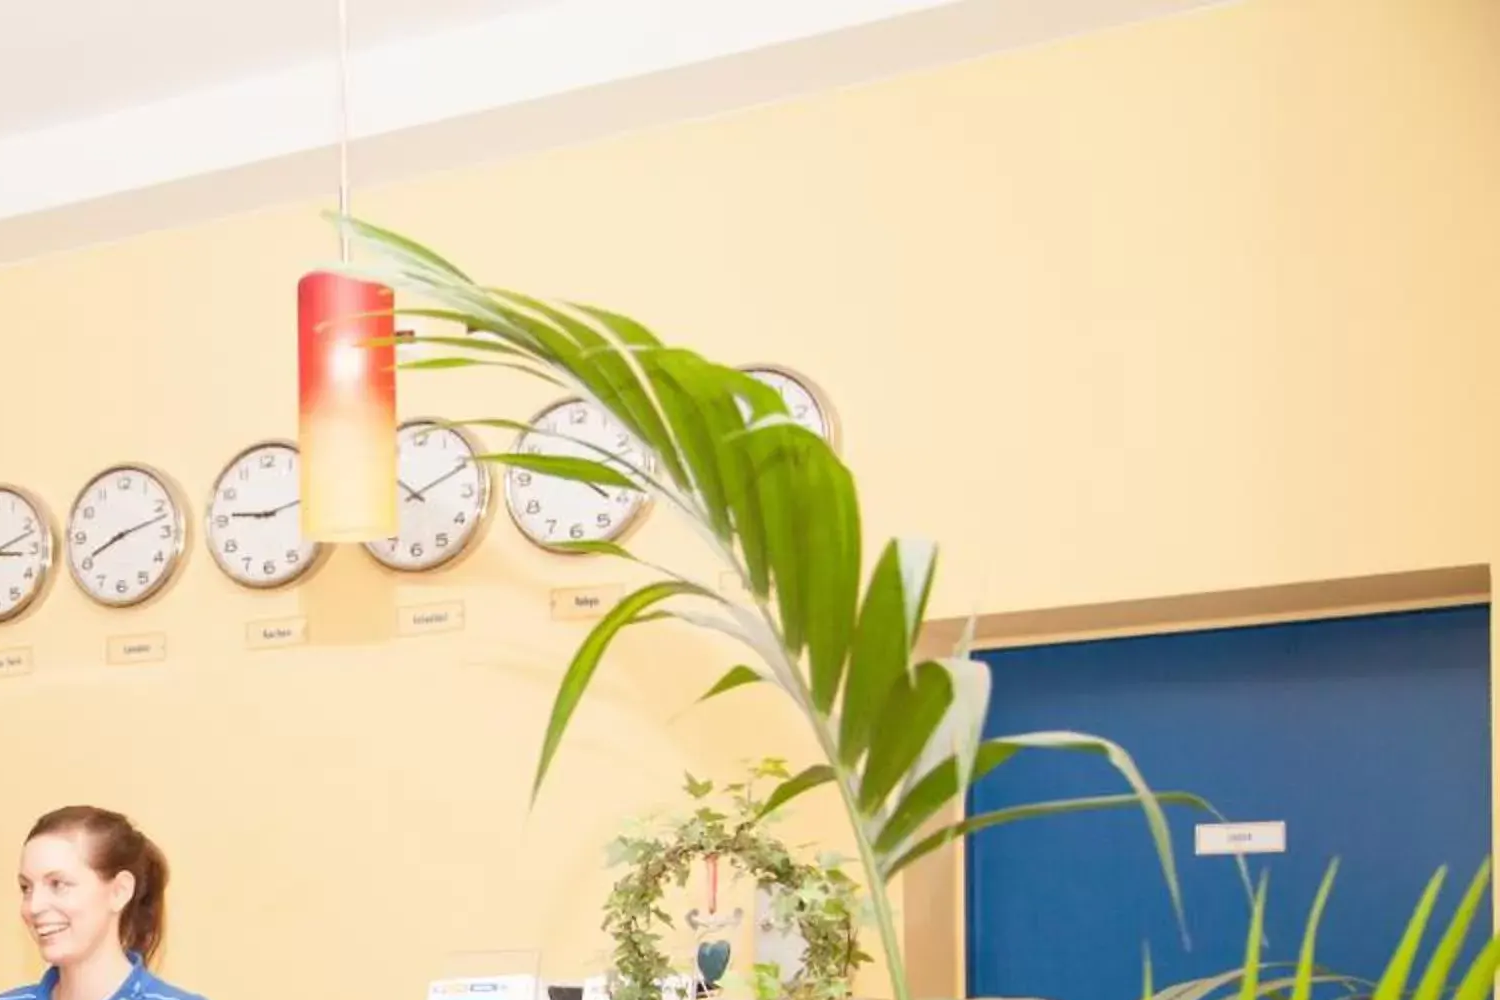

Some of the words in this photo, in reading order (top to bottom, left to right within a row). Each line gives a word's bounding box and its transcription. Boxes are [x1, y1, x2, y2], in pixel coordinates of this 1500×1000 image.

[569, 408, 588, 426] 12
[260, 454, 276, 469] 12
[517, 473, 532, 487] 9
[460, 483, 474, 499] 3
[153, 499, 165, 514] 2
[526, 499, 540, 515] 8
[215, 514, 230, 529] 9
[453, 511, 466, 525] 4
[596, 513, 612, 528] 5
[159, 524, 172, 539] 3
[545, 519, 558, 534] 7
[569, 523, 584, 539] 6
[74, 531, 87, 545] 9
[224, 538, 238, 553] 8
[387, 536, 399, 552] 7
[435, 532, 449, 548] 5
[153, 550, 164, 563] 4
[285, 549, 299, 564] 5
[409, 541, 424, 557] 6
[241, 556, 253, 572] 7
[263, 560, 276, 575] 6
[23, 566, 33, 580] 4
[137, 570, 149, 585] 5
[96, 574, 107, 588] 7
[116, 579, 128, 593] 6
